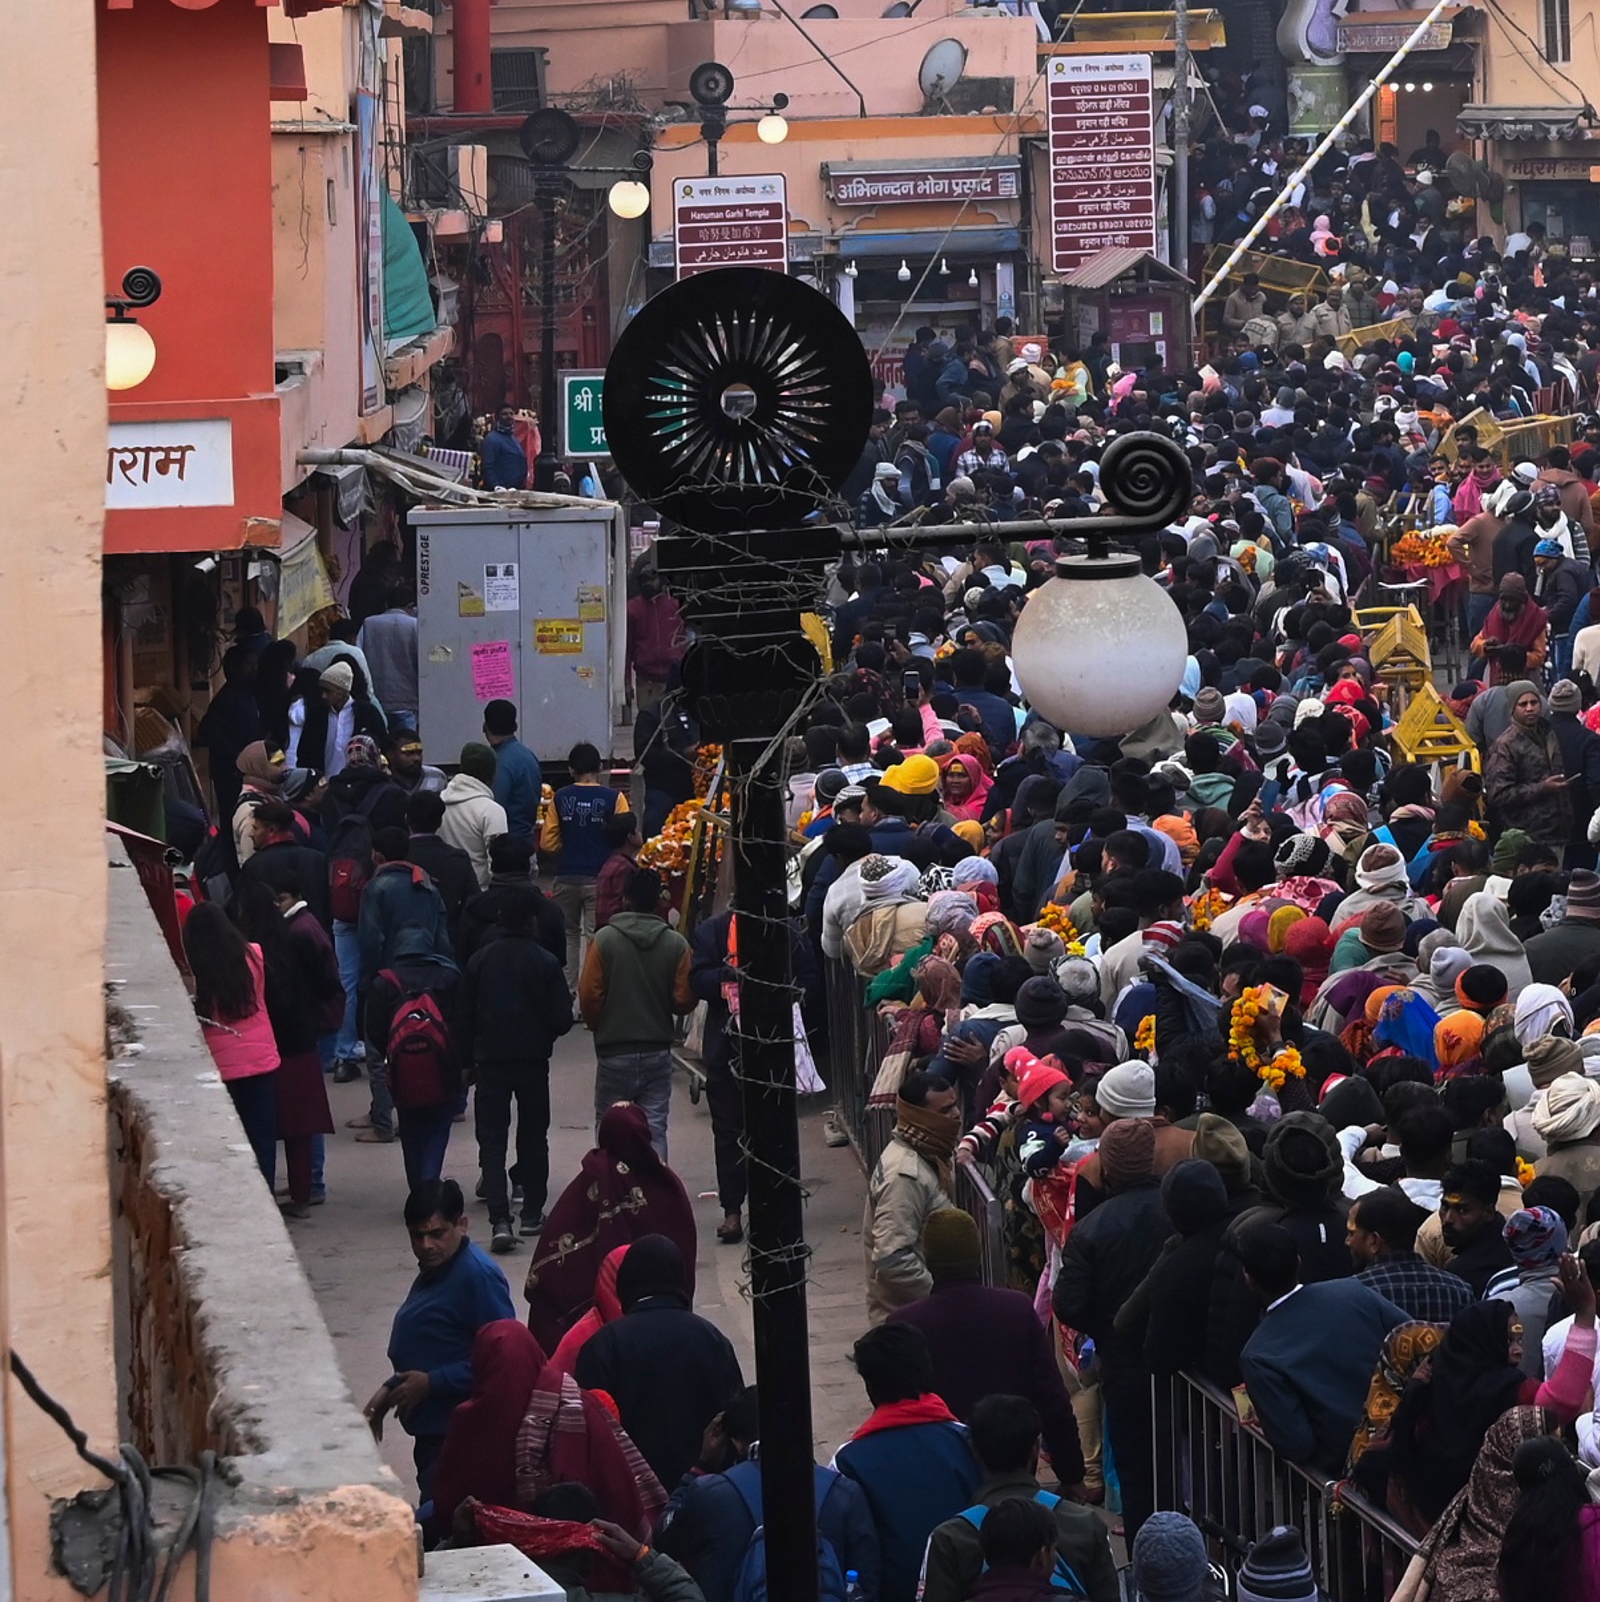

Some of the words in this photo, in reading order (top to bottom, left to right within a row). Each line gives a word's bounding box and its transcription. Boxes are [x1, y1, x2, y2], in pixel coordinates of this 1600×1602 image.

[837, 178, 915, 199] अभिनन्दन
[916, 175, 949, 195] भोग
[951, 177, 993, 197] प्रसाद
[690, 210, 724, 221] Hanuman
[745, 207, 771, 220] Temple
[573, 386, 593, 412] श्री
